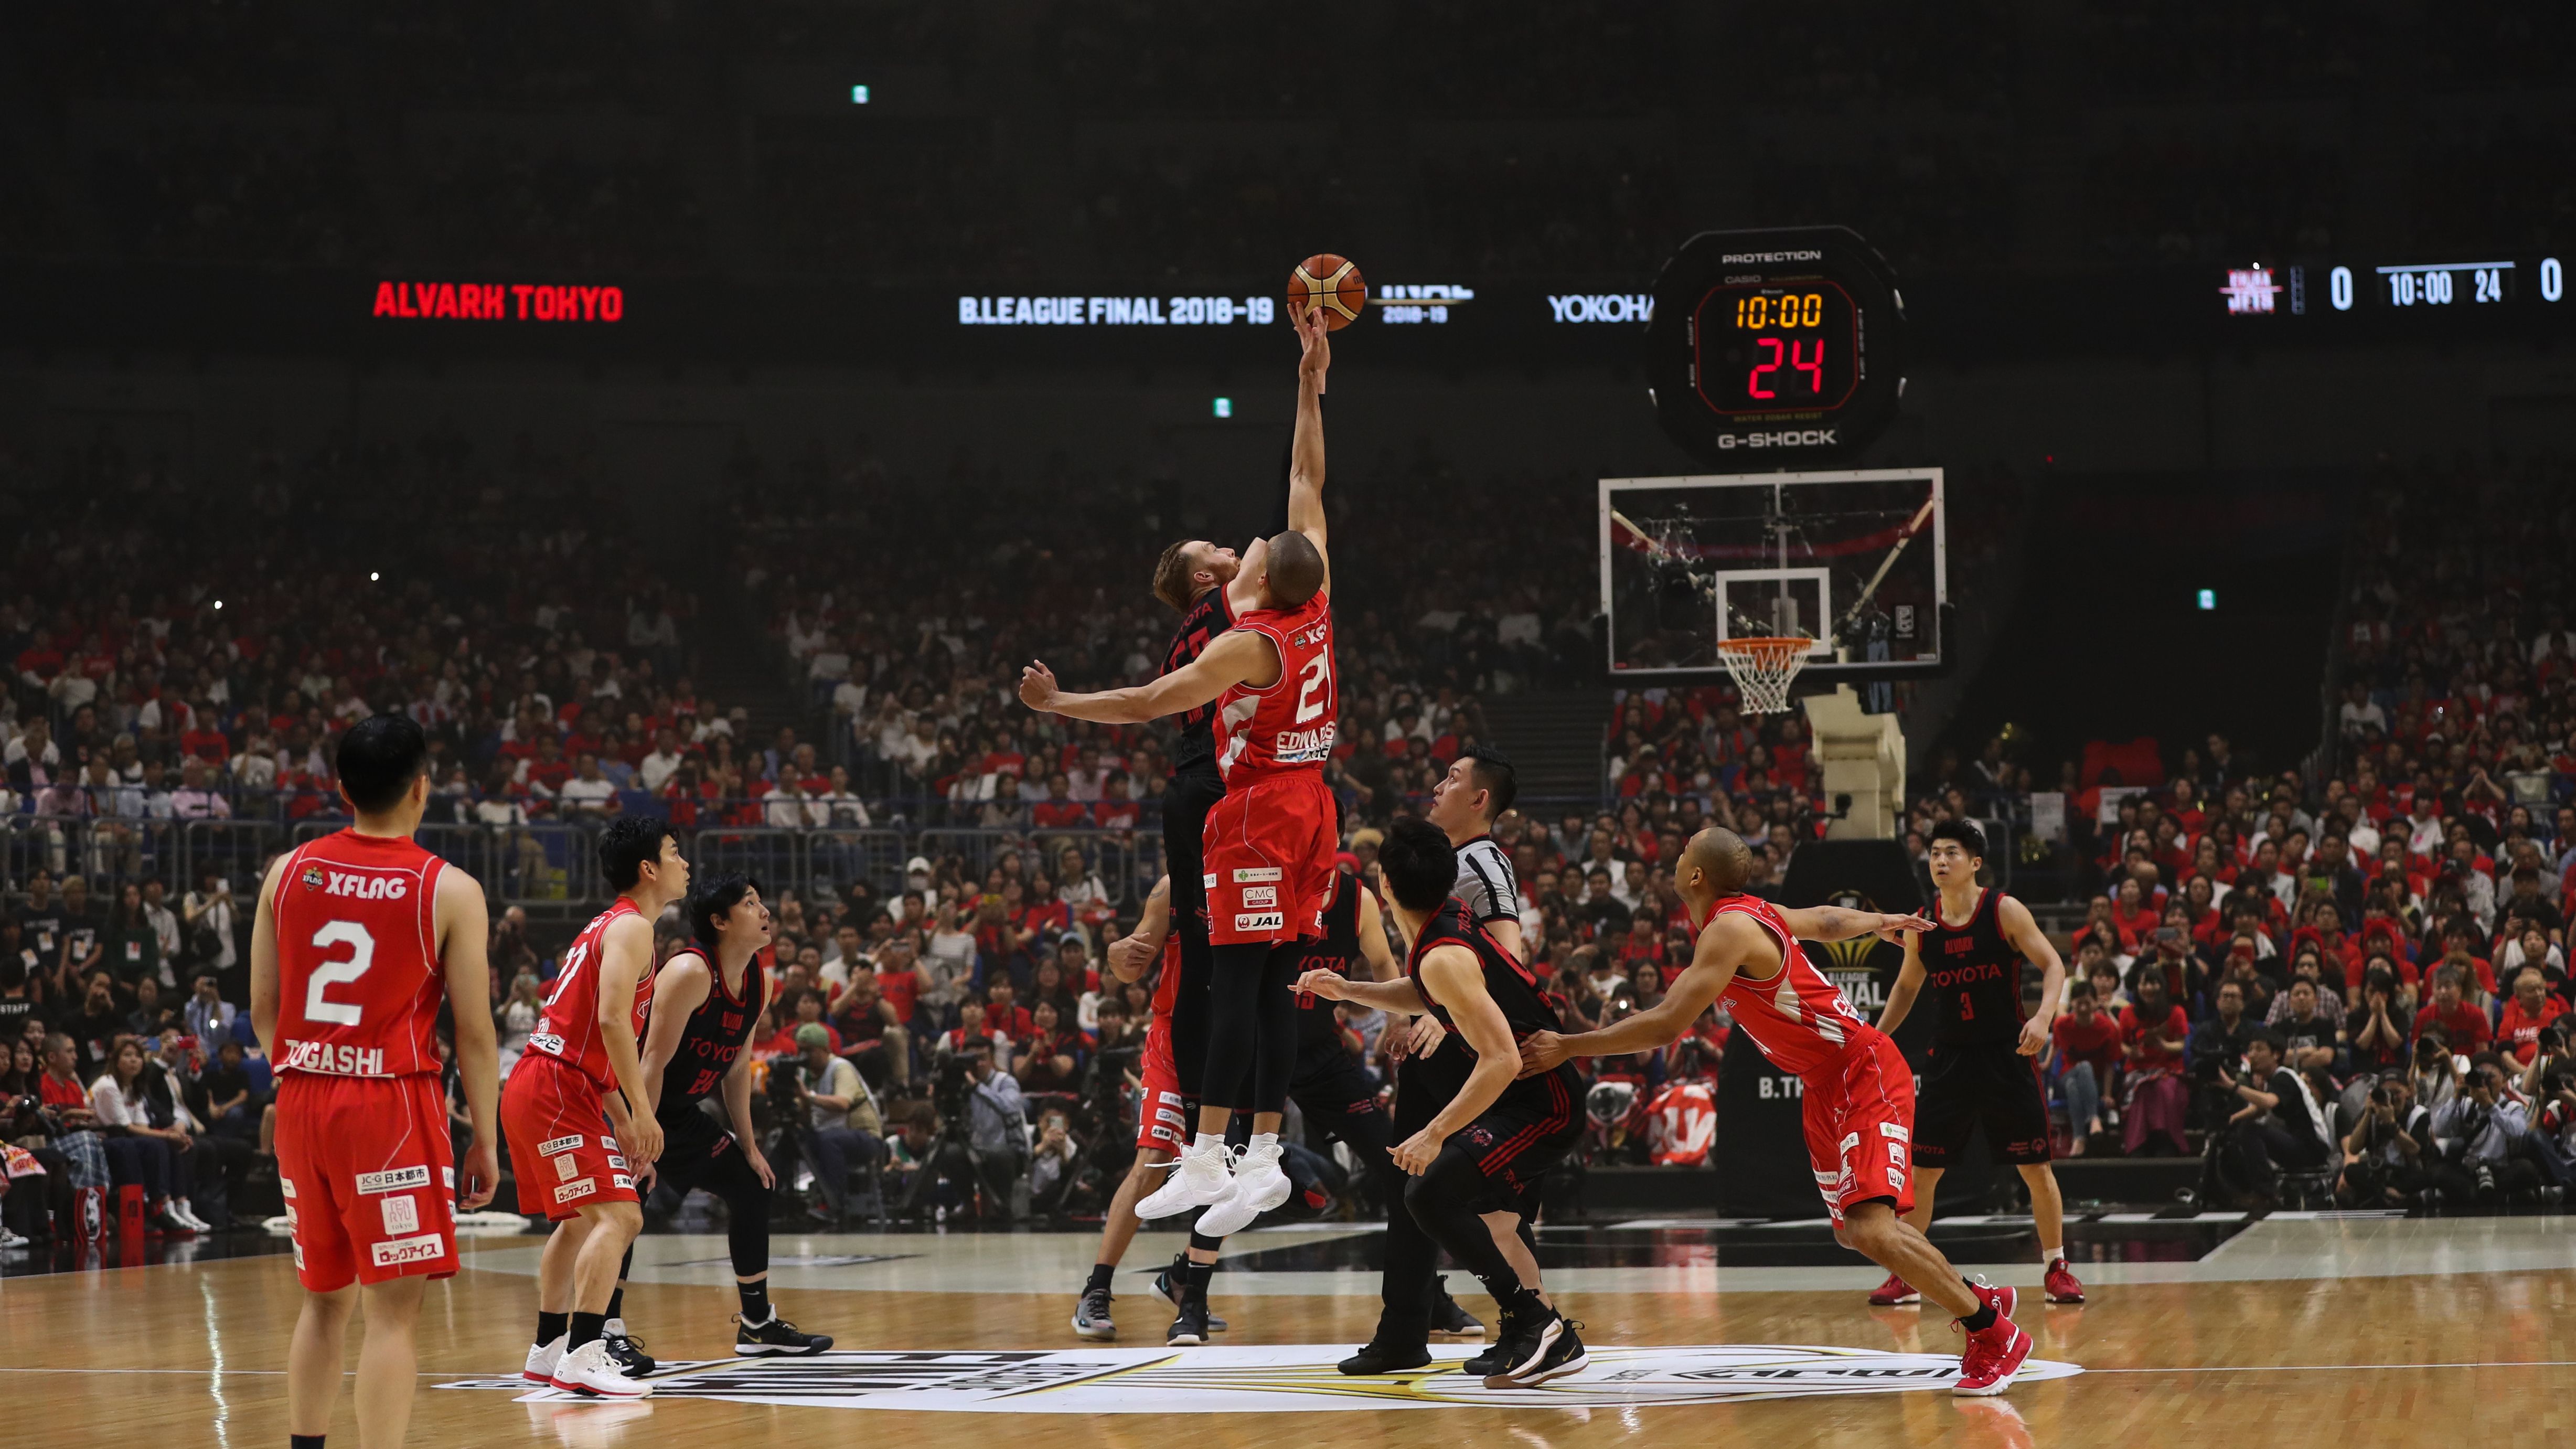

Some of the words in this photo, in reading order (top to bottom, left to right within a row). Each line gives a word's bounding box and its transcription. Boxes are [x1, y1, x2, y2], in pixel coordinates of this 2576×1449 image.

[1722, 250, 1822, 264] PROTECTION
[1724, 275, 1761, 284] CASIO
[2331, 265, 2354, 311] 0
[2389, 271, 2453, 306] 10:00
[2475, 269, 2502, 303] 24
[2540, 257, 2563, 302] 0
[373, 280, 506, 321] ALVARK
[510, 284, 623, 323] TOKYO
[958, 295, 1086, 325] B.LEAGUE
[1088, 296, 1168, 325] FINAL
[1169, 296, 1275, 325] 2018-19
[1736, 293, 1823, 329] 10:00
[1748, 337, 1826, 400] 24
[1718, 429, 1837, 449] G-SHOCK
[325, 871, 407, 900] XFLAG
[1245, 888, 1274, 899] CMC
[1253, 916, 1281, 926] JAL
[304, 919, 376, 1027] 2
[1930, 963, 2003, 989] TOYOTA
[1960, 992, 1975, 1021] 3
[284, 1039, 384, 1075] TOGASHI
[1912, 1143, 1946, 1155] OYOTA
[362, 1175, 382, 1185] JC-G
[385, 1168, 425, 1184] 日本都市
[388, 1198, 410, 1210] TEN
[558, 1184, 592, 1201] ロックアイス
[389, 1209, 412, 1223] RYU
[392, 1221, 413, 1231] tokyo
[379, 1242, 437, 1263] ロックアイス
